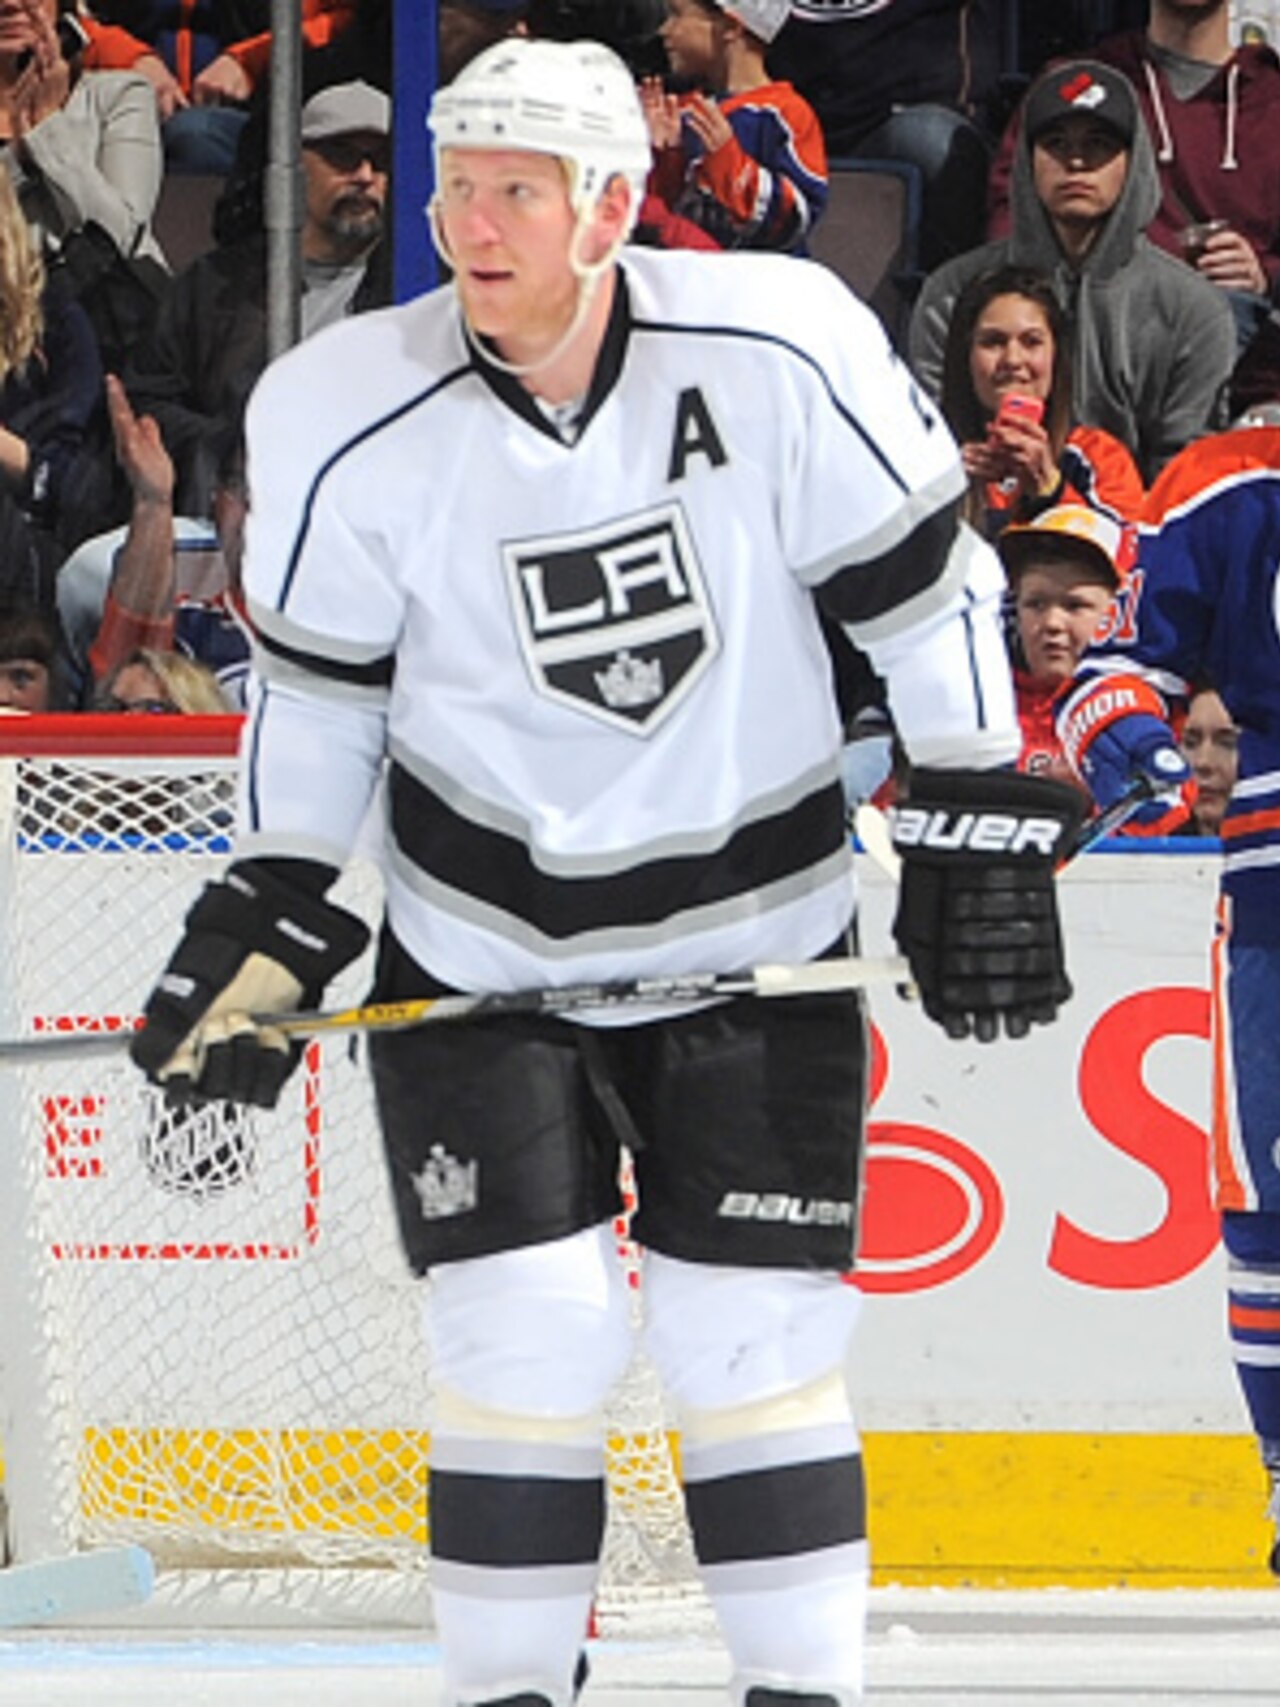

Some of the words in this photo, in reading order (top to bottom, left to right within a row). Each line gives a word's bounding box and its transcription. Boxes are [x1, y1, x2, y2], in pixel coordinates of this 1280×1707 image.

[667, 386, 728, 483] A
[520, 530, 688, 632] LA
[889, 808, 1062, 854] AUER
